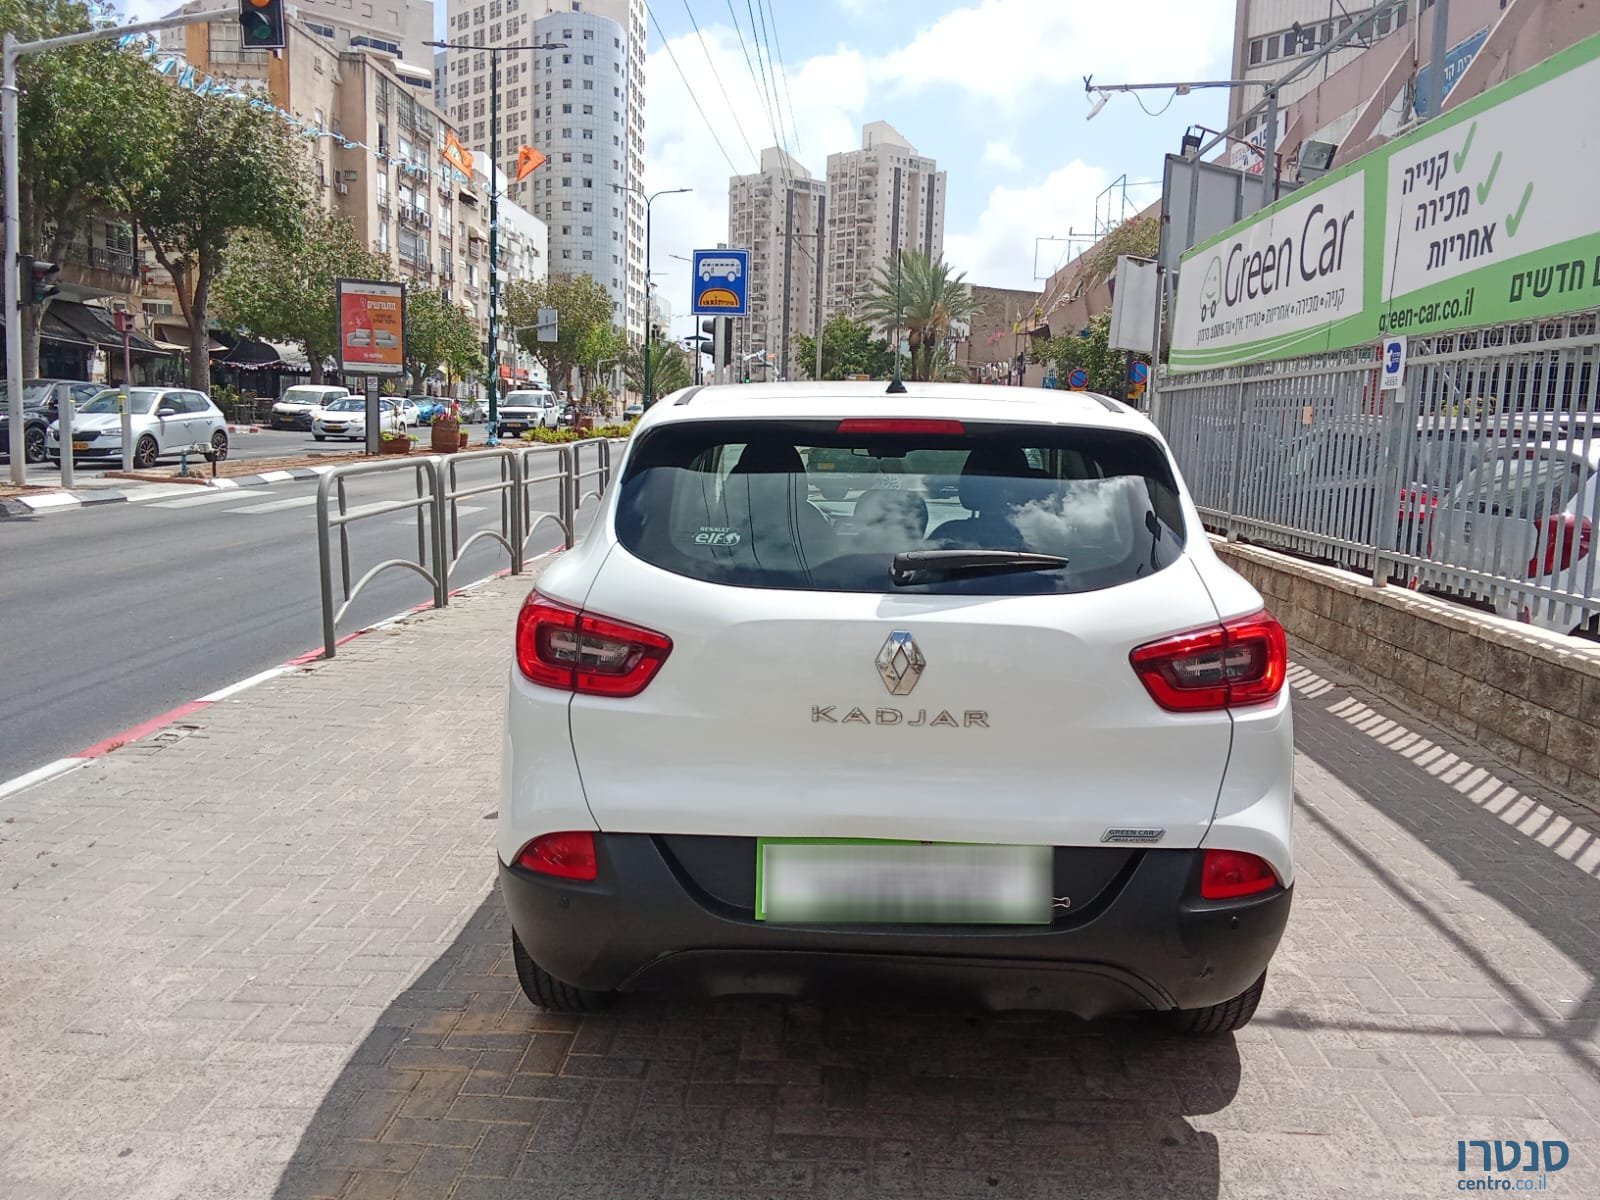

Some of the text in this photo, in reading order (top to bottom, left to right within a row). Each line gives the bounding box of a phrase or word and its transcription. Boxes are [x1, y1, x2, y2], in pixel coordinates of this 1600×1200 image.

[1402, 150, 1449, 195] קנייה
[1415, 185, 1471, 232] מכירה
[1225, 203, 1355, 307] Green Car
[1426, 222, 1497, 271] אחריות
[1324, 288, 1345, 311] קניה
[1509, 260, 1585, 303] חדשים
[1265, 303, 1290, 324] אחריות
[1295, 295, 1319, 317] מכירה
[1379, 287, 1475, 335] geen-car.co.il
[811, 705, 990, 729] KADJAR
